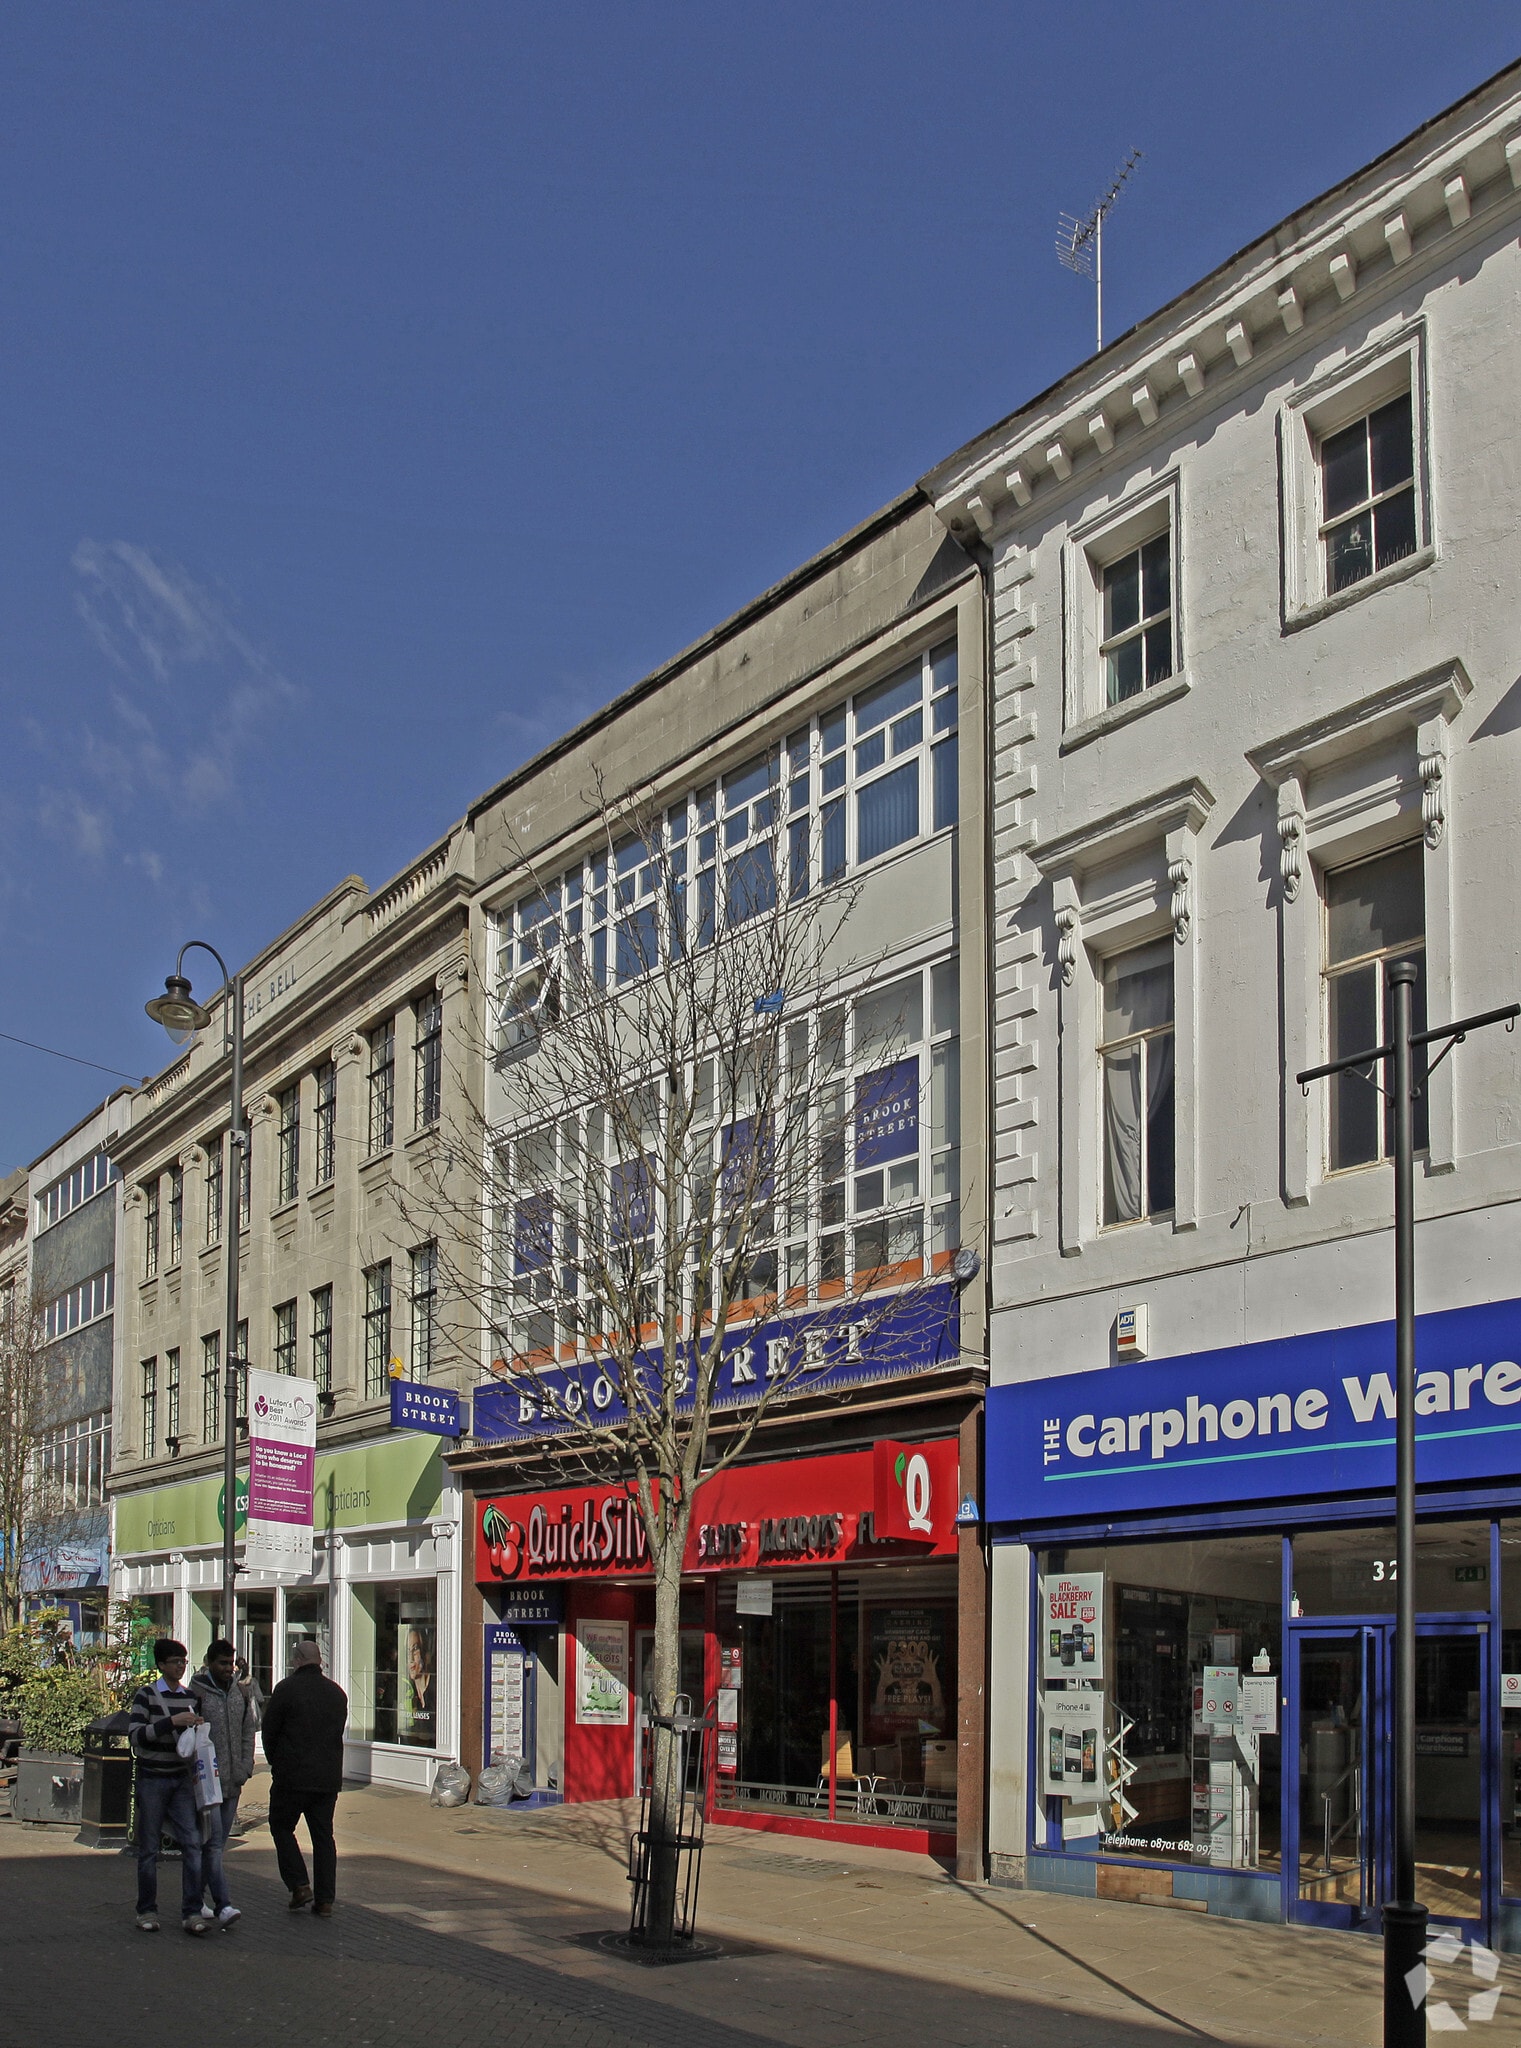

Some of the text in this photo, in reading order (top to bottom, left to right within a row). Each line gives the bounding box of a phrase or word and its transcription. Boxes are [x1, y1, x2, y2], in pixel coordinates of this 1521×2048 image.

[244, 965, 297, 1019] HE BELL
[1120, 1314, 1134, 1326] ADT
[269, 1398, 292, 1408] Luton's
[405, 1392, 449, 1409] BROOK
[269, 1406, 284, 1414] Best
[402, 1408, 455, 1425] STREET
[269, 1414, 307, 1427] 2011 Awards
[1043, 1418, 1060, 1466] THE
[1066, 1388, 1329, 1460] Carphone
[269, 1461, 296, 1471] honoured?
[280, 1457, 303, 1465] deserves
[326, 1488, 370, 1513] Opticians
[906, 1453, 933, 1535] Q
[147, 1519, 175, 1538] Opticians
[528, 1496, 648, 1566] QuickSilv
[759, 1512, 843, 1552] JACKPOTS
[858, 1511, 896, 1545] FU
[1372, 1560, 1397, 1581] 32
[1059, 1582, 1072, 1591] HTC
[510, 1590, 545, 1601] BROOK
[1050, 1591, 1093, 1602] BLACKBERRY
[507, 1608, 550, 1618] STREET
[1050, 1602, 1077, 1619] SALE
[595, 1653, 620, 1664] SLOTS
[599, 1680, 622, 1694] UK!
[1056, 1703, 1078, 1711] iPhone
[1420, 1735, 1464, 1743] Carphone
[1416, 1744, 1464, 1752] Warehouse
[735, 1787, 809, 1806] SLOTS JACKPOTS FUN
[887, 1801, 921, 1816] JACKPOTS
[930, 1805, 947, 1819] FUN
[1104, 1833, 1148, 1847] Telephone:
[1150, 1838, 1175, 1851] 08701
[1178, 1840, 1194, 1852] 682
